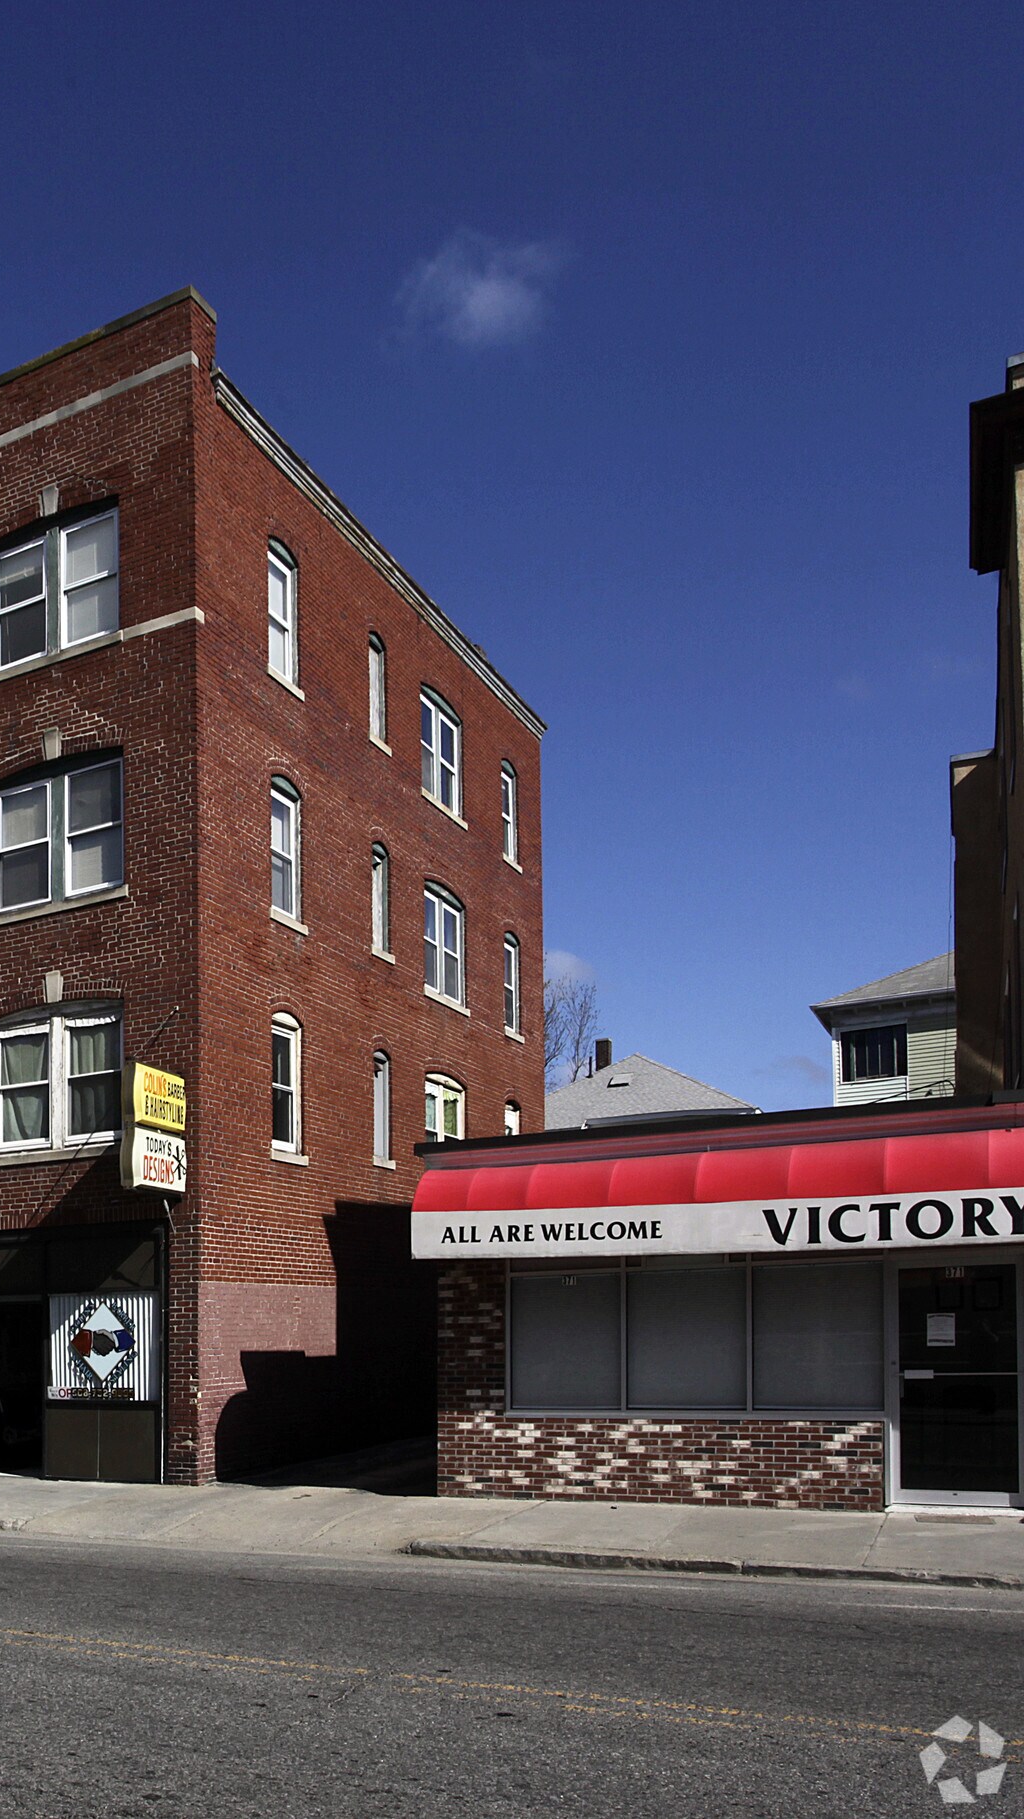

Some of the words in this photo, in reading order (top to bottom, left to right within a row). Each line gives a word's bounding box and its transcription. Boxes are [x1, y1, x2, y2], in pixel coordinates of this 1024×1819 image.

[143, 1071, 167, 1098] COLIN'S
[167, 1081, 185, 1100] BARBER
[146, 1136, 172, 1157] TODAY'S
[143, 1155, 175, 1185] DESIGNS
[441, 1225, 481, 1244] ALL
[489, 1224, 535, 1243] ARE
[540, 1220, 663, 1242] WELCOME
[561, 1275, 576, 1286] 371
[945, 1266, 964, 1278] 371
